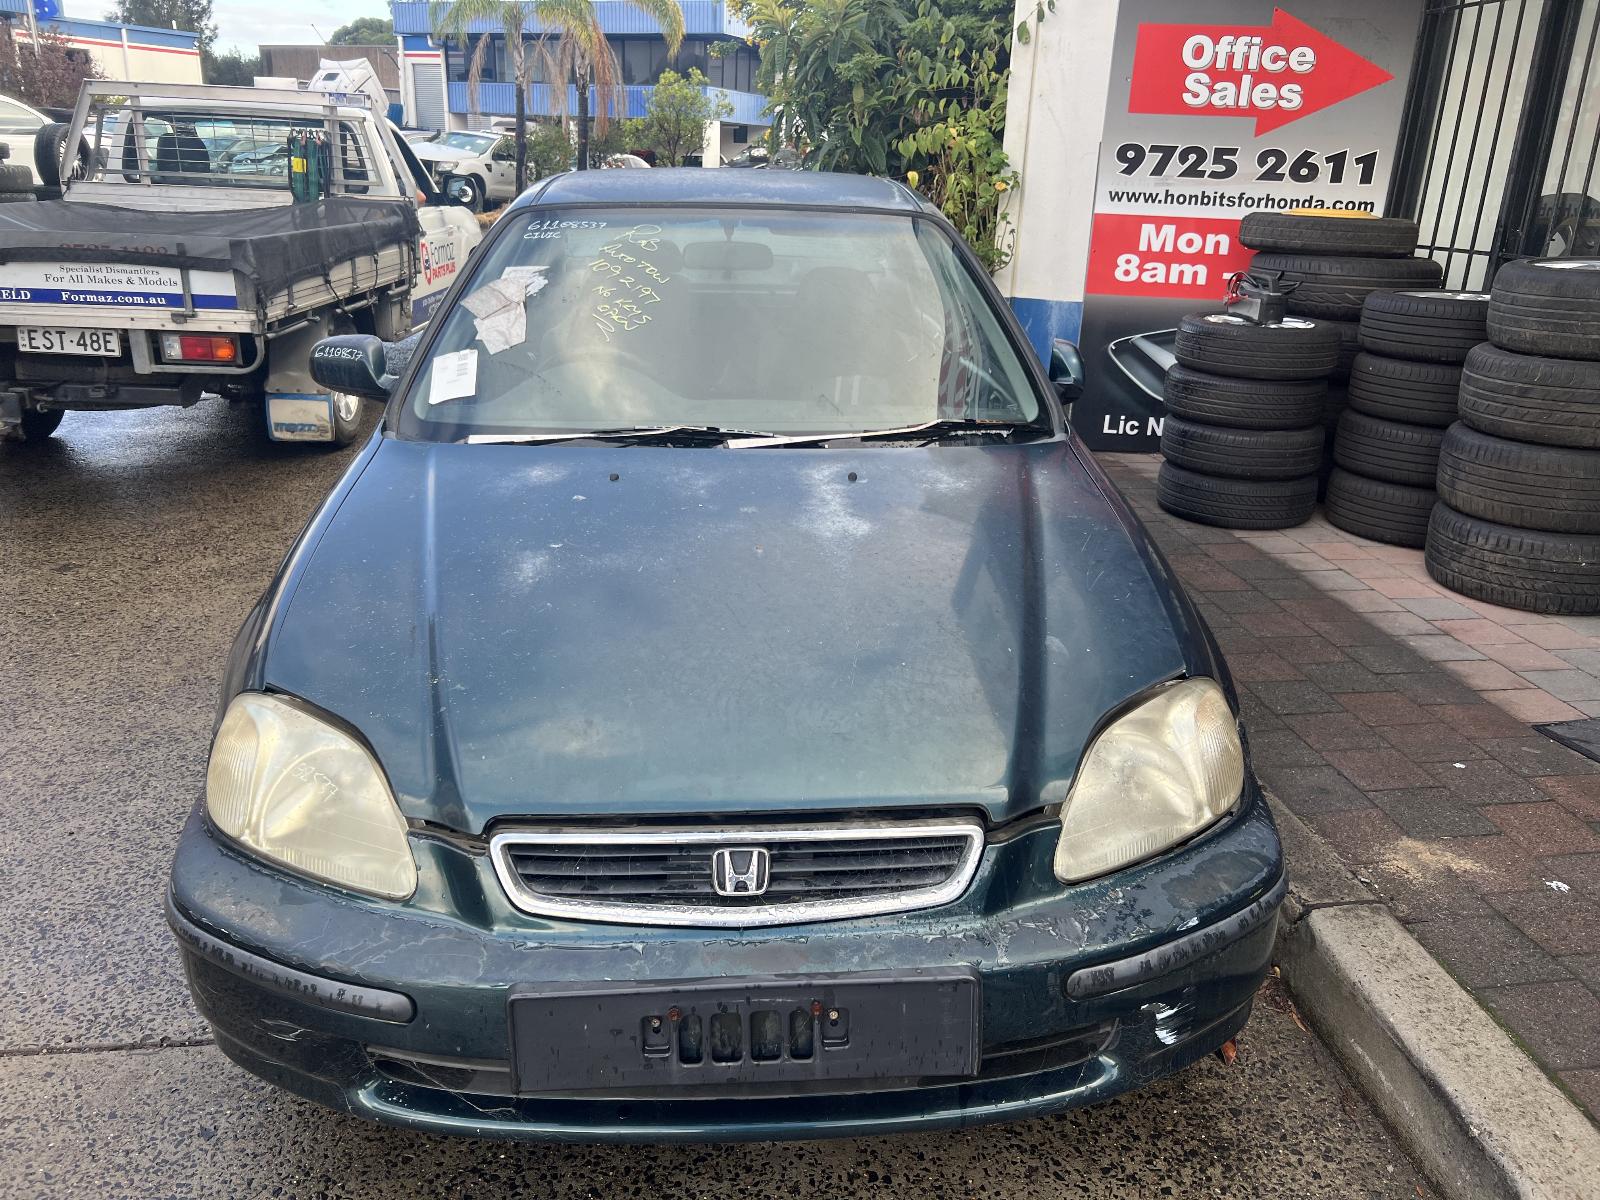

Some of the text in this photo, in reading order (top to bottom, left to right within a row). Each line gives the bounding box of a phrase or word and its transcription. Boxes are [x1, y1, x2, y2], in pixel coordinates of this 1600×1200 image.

[1182, 34, 1316, 73] Office
[1181, 72, 1303, 109] Sales
[1115, 142, 1380, 186] 9725 2611
[1108, 188, 1375, 213] www.honbitsforhonda.com
[523, 231, 561, 239] CIVIC
[527, 220, 607, 231] 61108537
[1138, 223, 1230, 256] Mon
[430, 241, 455, 266] Formaz
[44, 273, 179, 287] For All Makes & Models
[58, 264, 161, 275] Specialist Dismantlers
[432, 261, 456, 280] PARTS PLUS
[1114, 253, 1208, 286] 8am
[61, 291, 167, 305] Formaz.com.au
[1102, 414, 1140, 435] Lic
